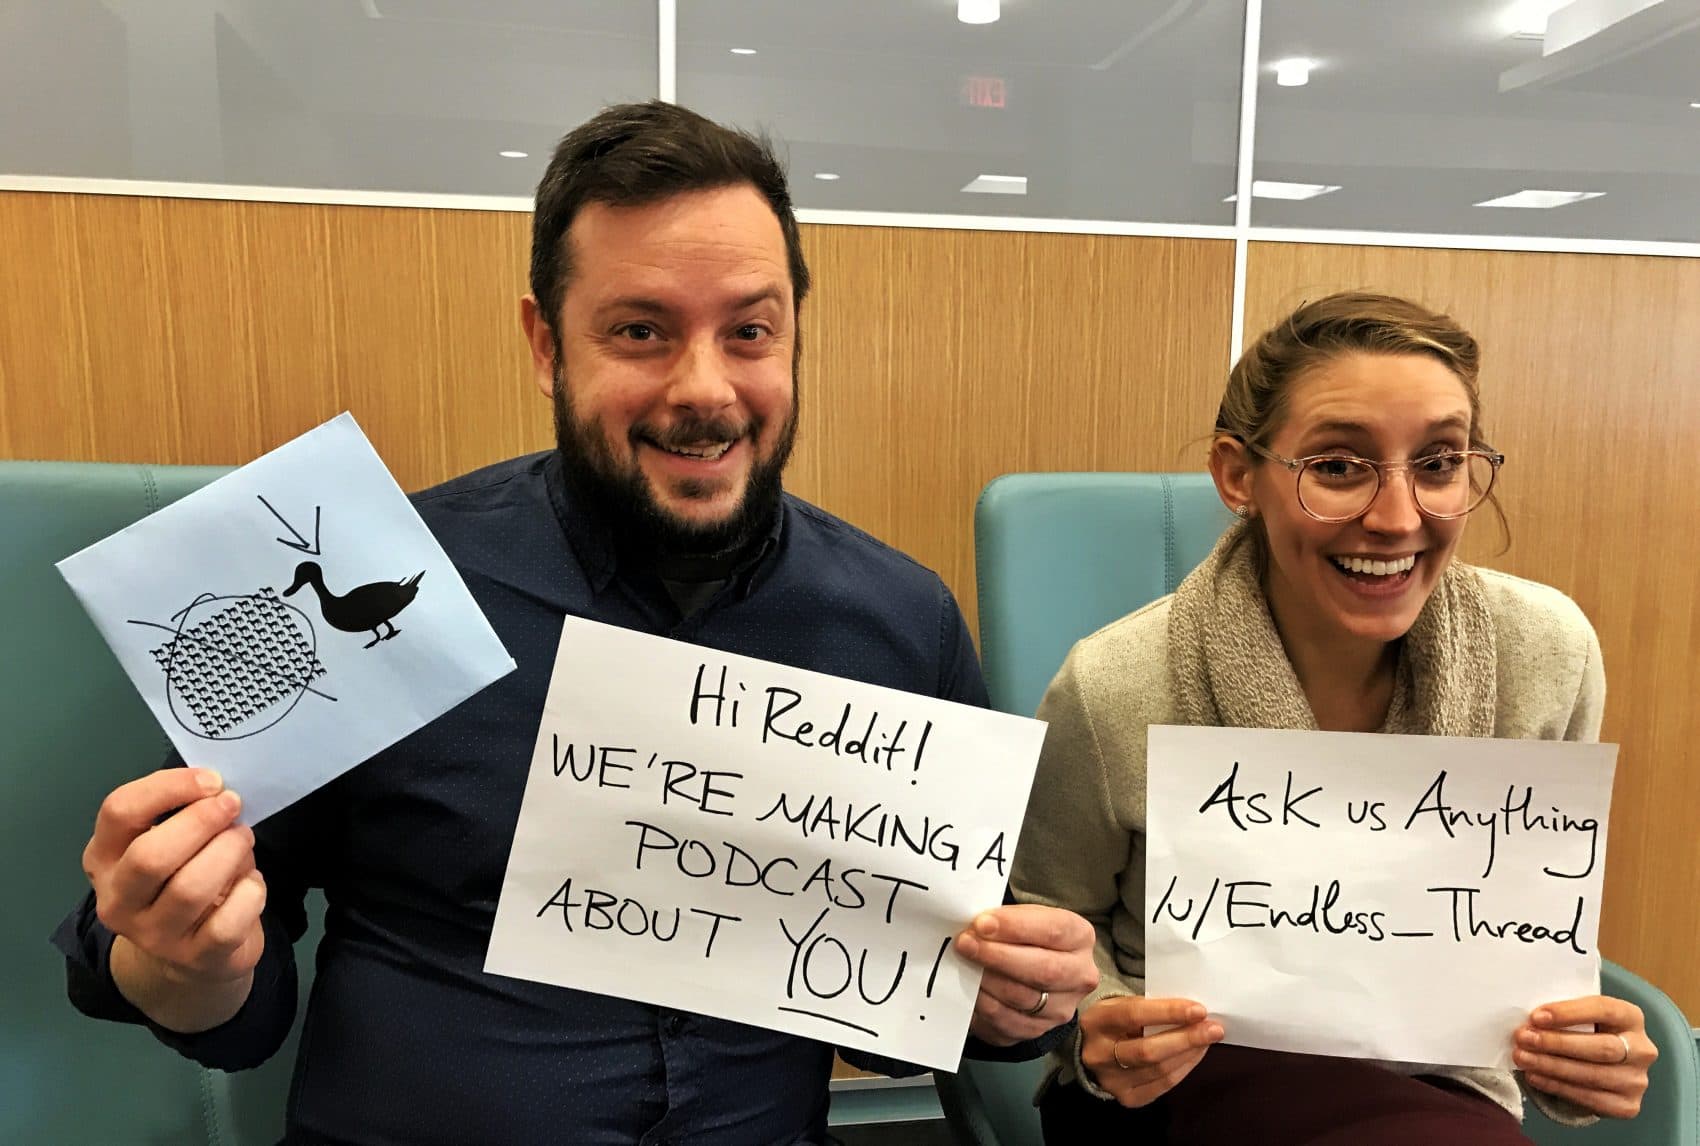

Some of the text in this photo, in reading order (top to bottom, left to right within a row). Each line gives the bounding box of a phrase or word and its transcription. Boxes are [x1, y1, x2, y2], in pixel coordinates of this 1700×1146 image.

[690, 663, 933, 785] Hi Reddit!
[553, 733, 1006, 876] WE'RE MAKING A
[1347, 800, 1387, 832] us
[1404, 770, 1599, 879] Anything
[625, 820, 929, 924] PODCAST
[536, 877, 953, 1021] ABOUT YOU!
